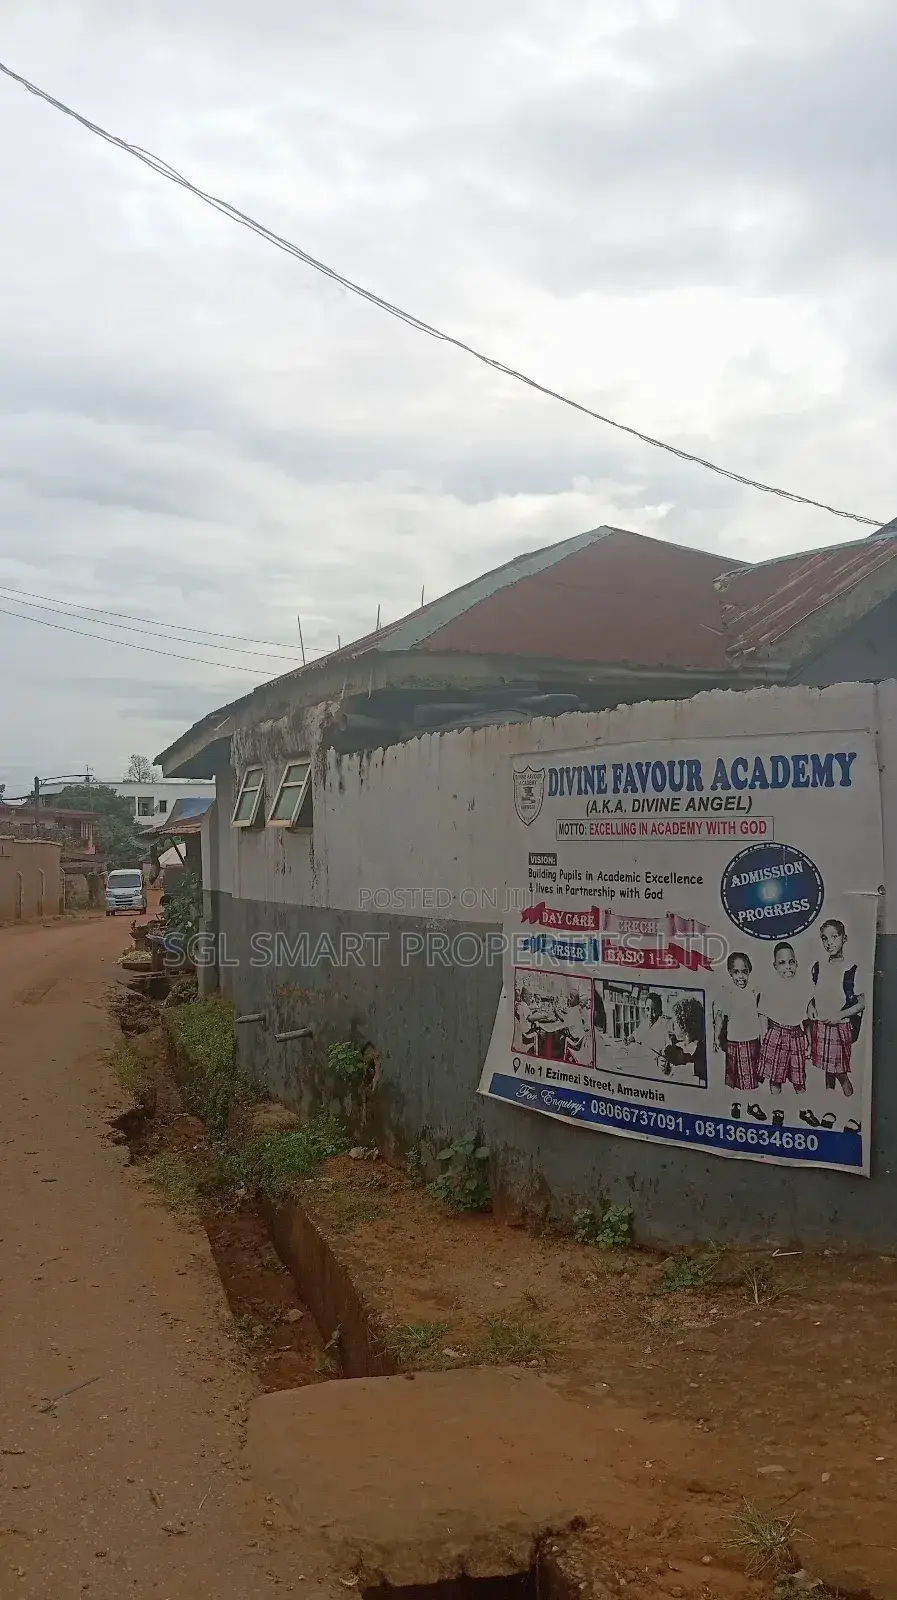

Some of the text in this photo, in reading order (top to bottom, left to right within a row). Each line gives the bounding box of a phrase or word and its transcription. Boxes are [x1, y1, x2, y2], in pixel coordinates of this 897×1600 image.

[548, 752, 857, 797] DIVINE FAVOUR ACADEMY
[586, 796, 753, 816] (A.K.A. DIVINE ANGEL)
[558, 819, 767, 836] MOTTO: EXCELLING IN ACADEMY WITH GOD
[530, 855, 556, 865] VISION:
[528, 868, 704, 885] Building Pupils in Academic Excellence
[730, 861, 804, 888] ADMISSION
[535, 884, 554, 894] lives
[556, 884, 563, 894] in
[565, 885, 615, 900] Partnership
[620, 886, 640, 899] with
[644, 888, 663, 899] God
[542, 910, 595, 927] DAY CARE
[737, 898, 810, 923] PROGRESS
[606, 949, 645, 964] BASIC
[524, 1062, 666, 1102] No 1 Ezimezi Street, Amawbia
[515, 1083, 538, 1100] For
[540, 1088, 586, 1116] Enquiry:
[694, 1119, 819, 1151] 08136634680
